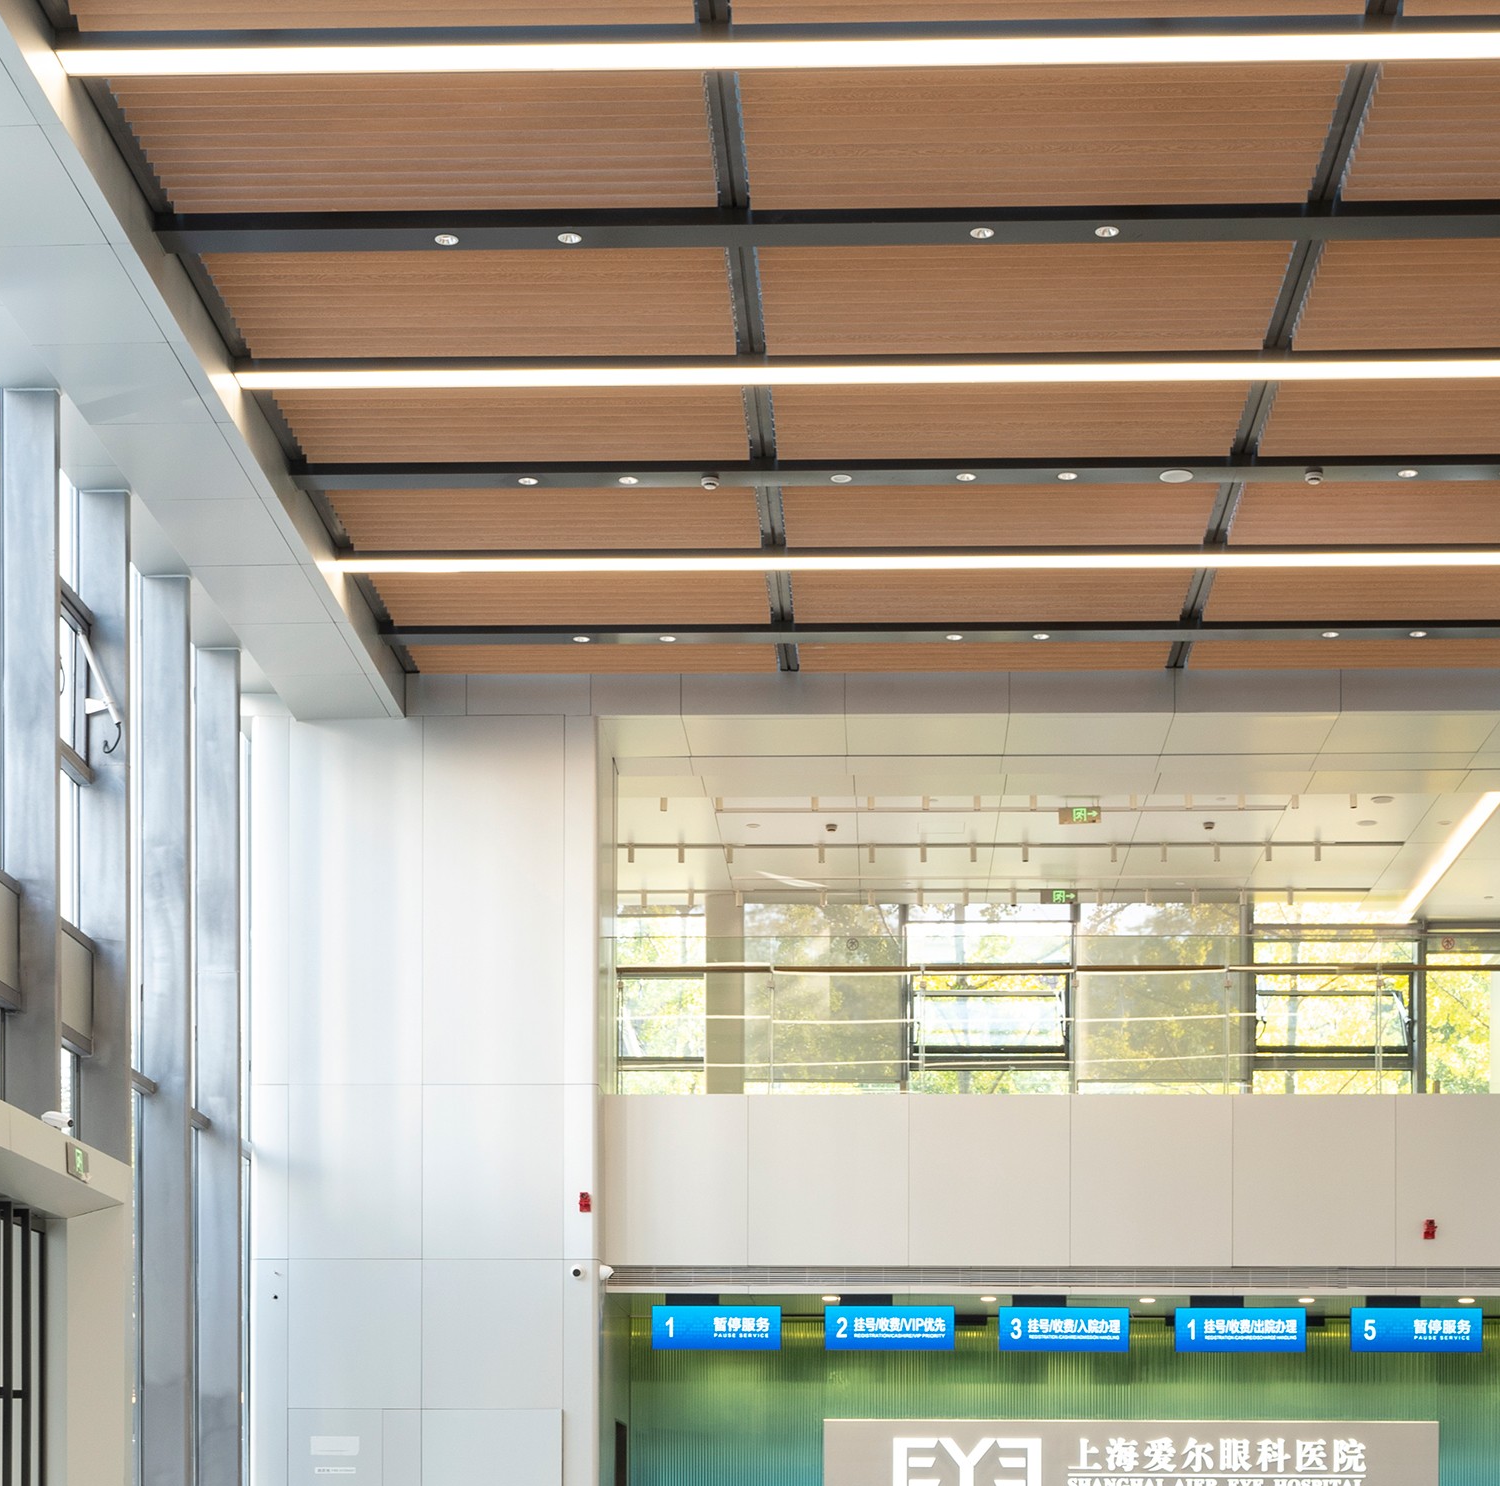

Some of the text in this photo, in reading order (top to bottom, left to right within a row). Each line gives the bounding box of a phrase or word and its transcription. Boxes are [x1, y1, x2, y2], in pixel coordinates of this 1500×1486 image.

[665, 1317, 674, 1338] 1
[713, 1317, 770, 1332] 暂停服务
[836, 1317, 848, 1338] 2
[853, 1317, 946, 1332] 挂号/收费/VIP优先
[1010, 1318, 1022, 1339] 3
[1028, 1318, 1120, 1333] 挂号/收费/入院办理
[1187, 1318, 1196, 1340] 1
[1204, 1318, 1297, 1334] 挂号/收费/出院办理
[1363, 1319, 1376, 1340] 5
[1413, 1319, 1471, 1334] 暂停服务
[1067, 1437, 1367, 1472] 上海爱尔眼科医院
